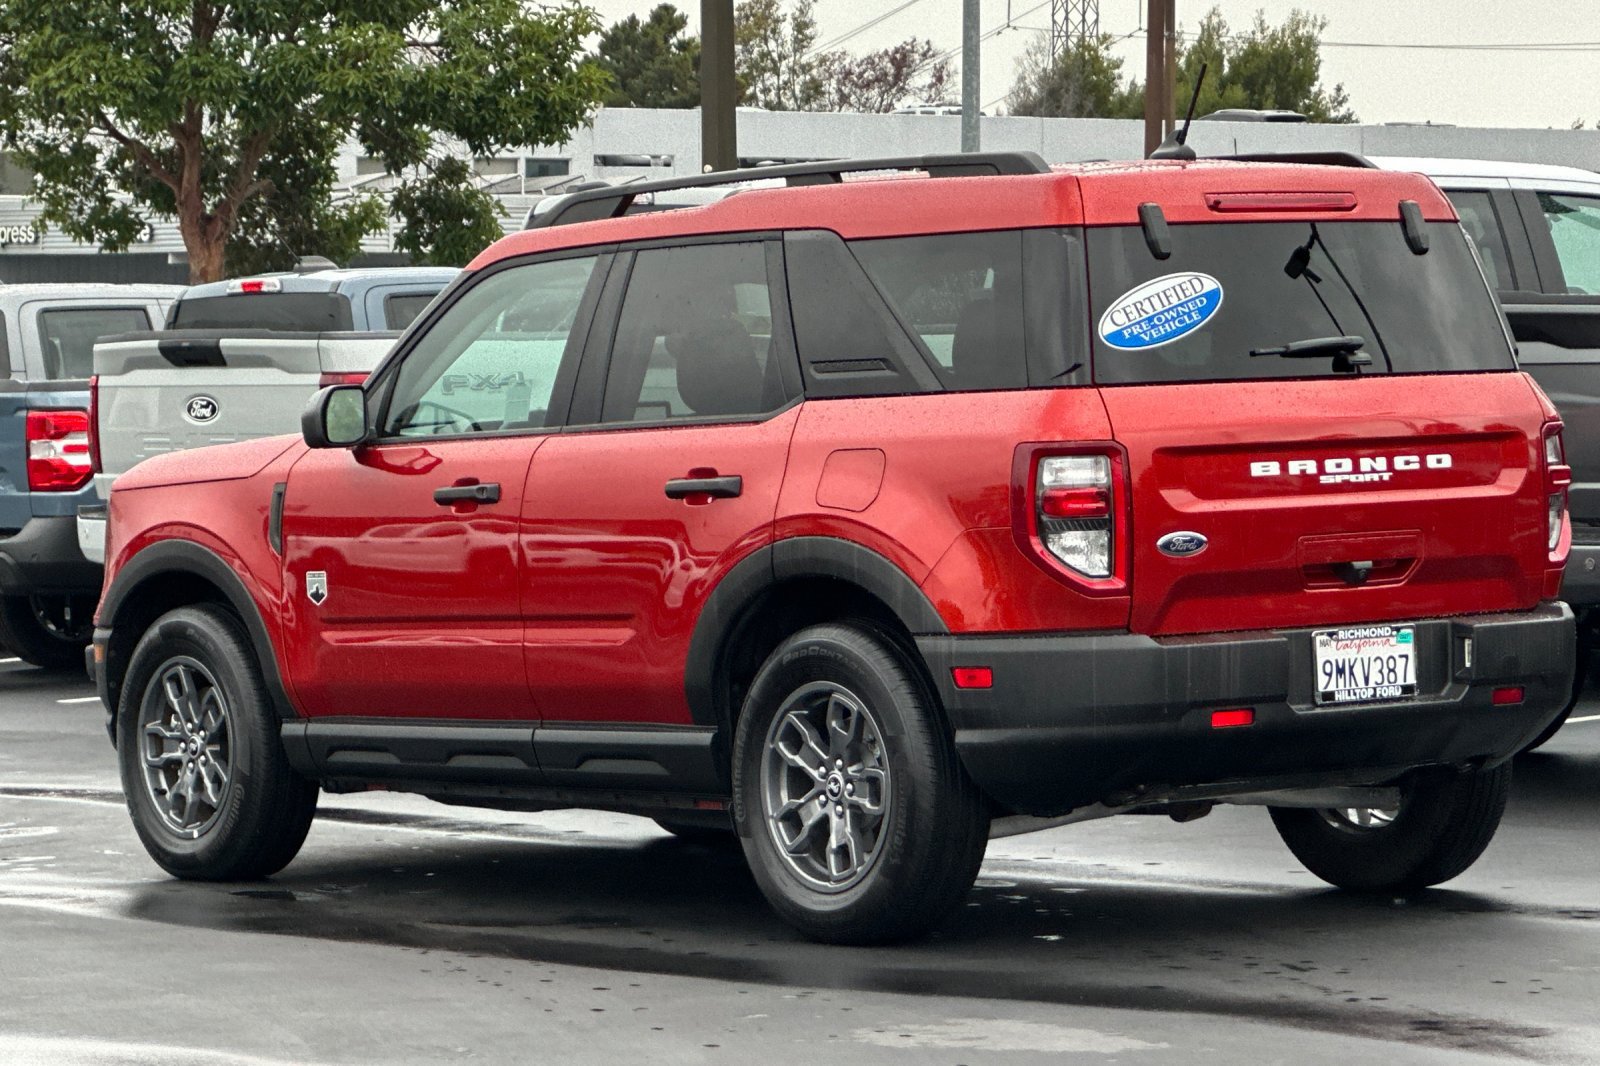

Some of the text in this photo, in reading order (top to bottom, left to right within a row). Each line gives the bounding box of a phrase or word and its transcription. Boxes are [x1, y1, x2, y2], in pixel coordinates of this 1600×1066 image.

[1110, 277, 1205, 327] CERTIFIED
[1122, 297, 1207, 339] PRE-OWNED
[1140, 311, 1201, 342] VEHICLE
[190, 400, 213, 417] Ford
[1250, 453, 1452, 477] BRONCO
[1319, 472, 1393, 484] SPORT
[1170, 536, 1198, 550] Ford
[1338, 627, 1392, 640] RICHMOND
[1335, 638, 1398, 654] California
[1322, 653, 1409, 690] 9MKV387
[1334, 687, 1374, 701] HILLTOP
[1376, 685, 1402, 698] FORD
